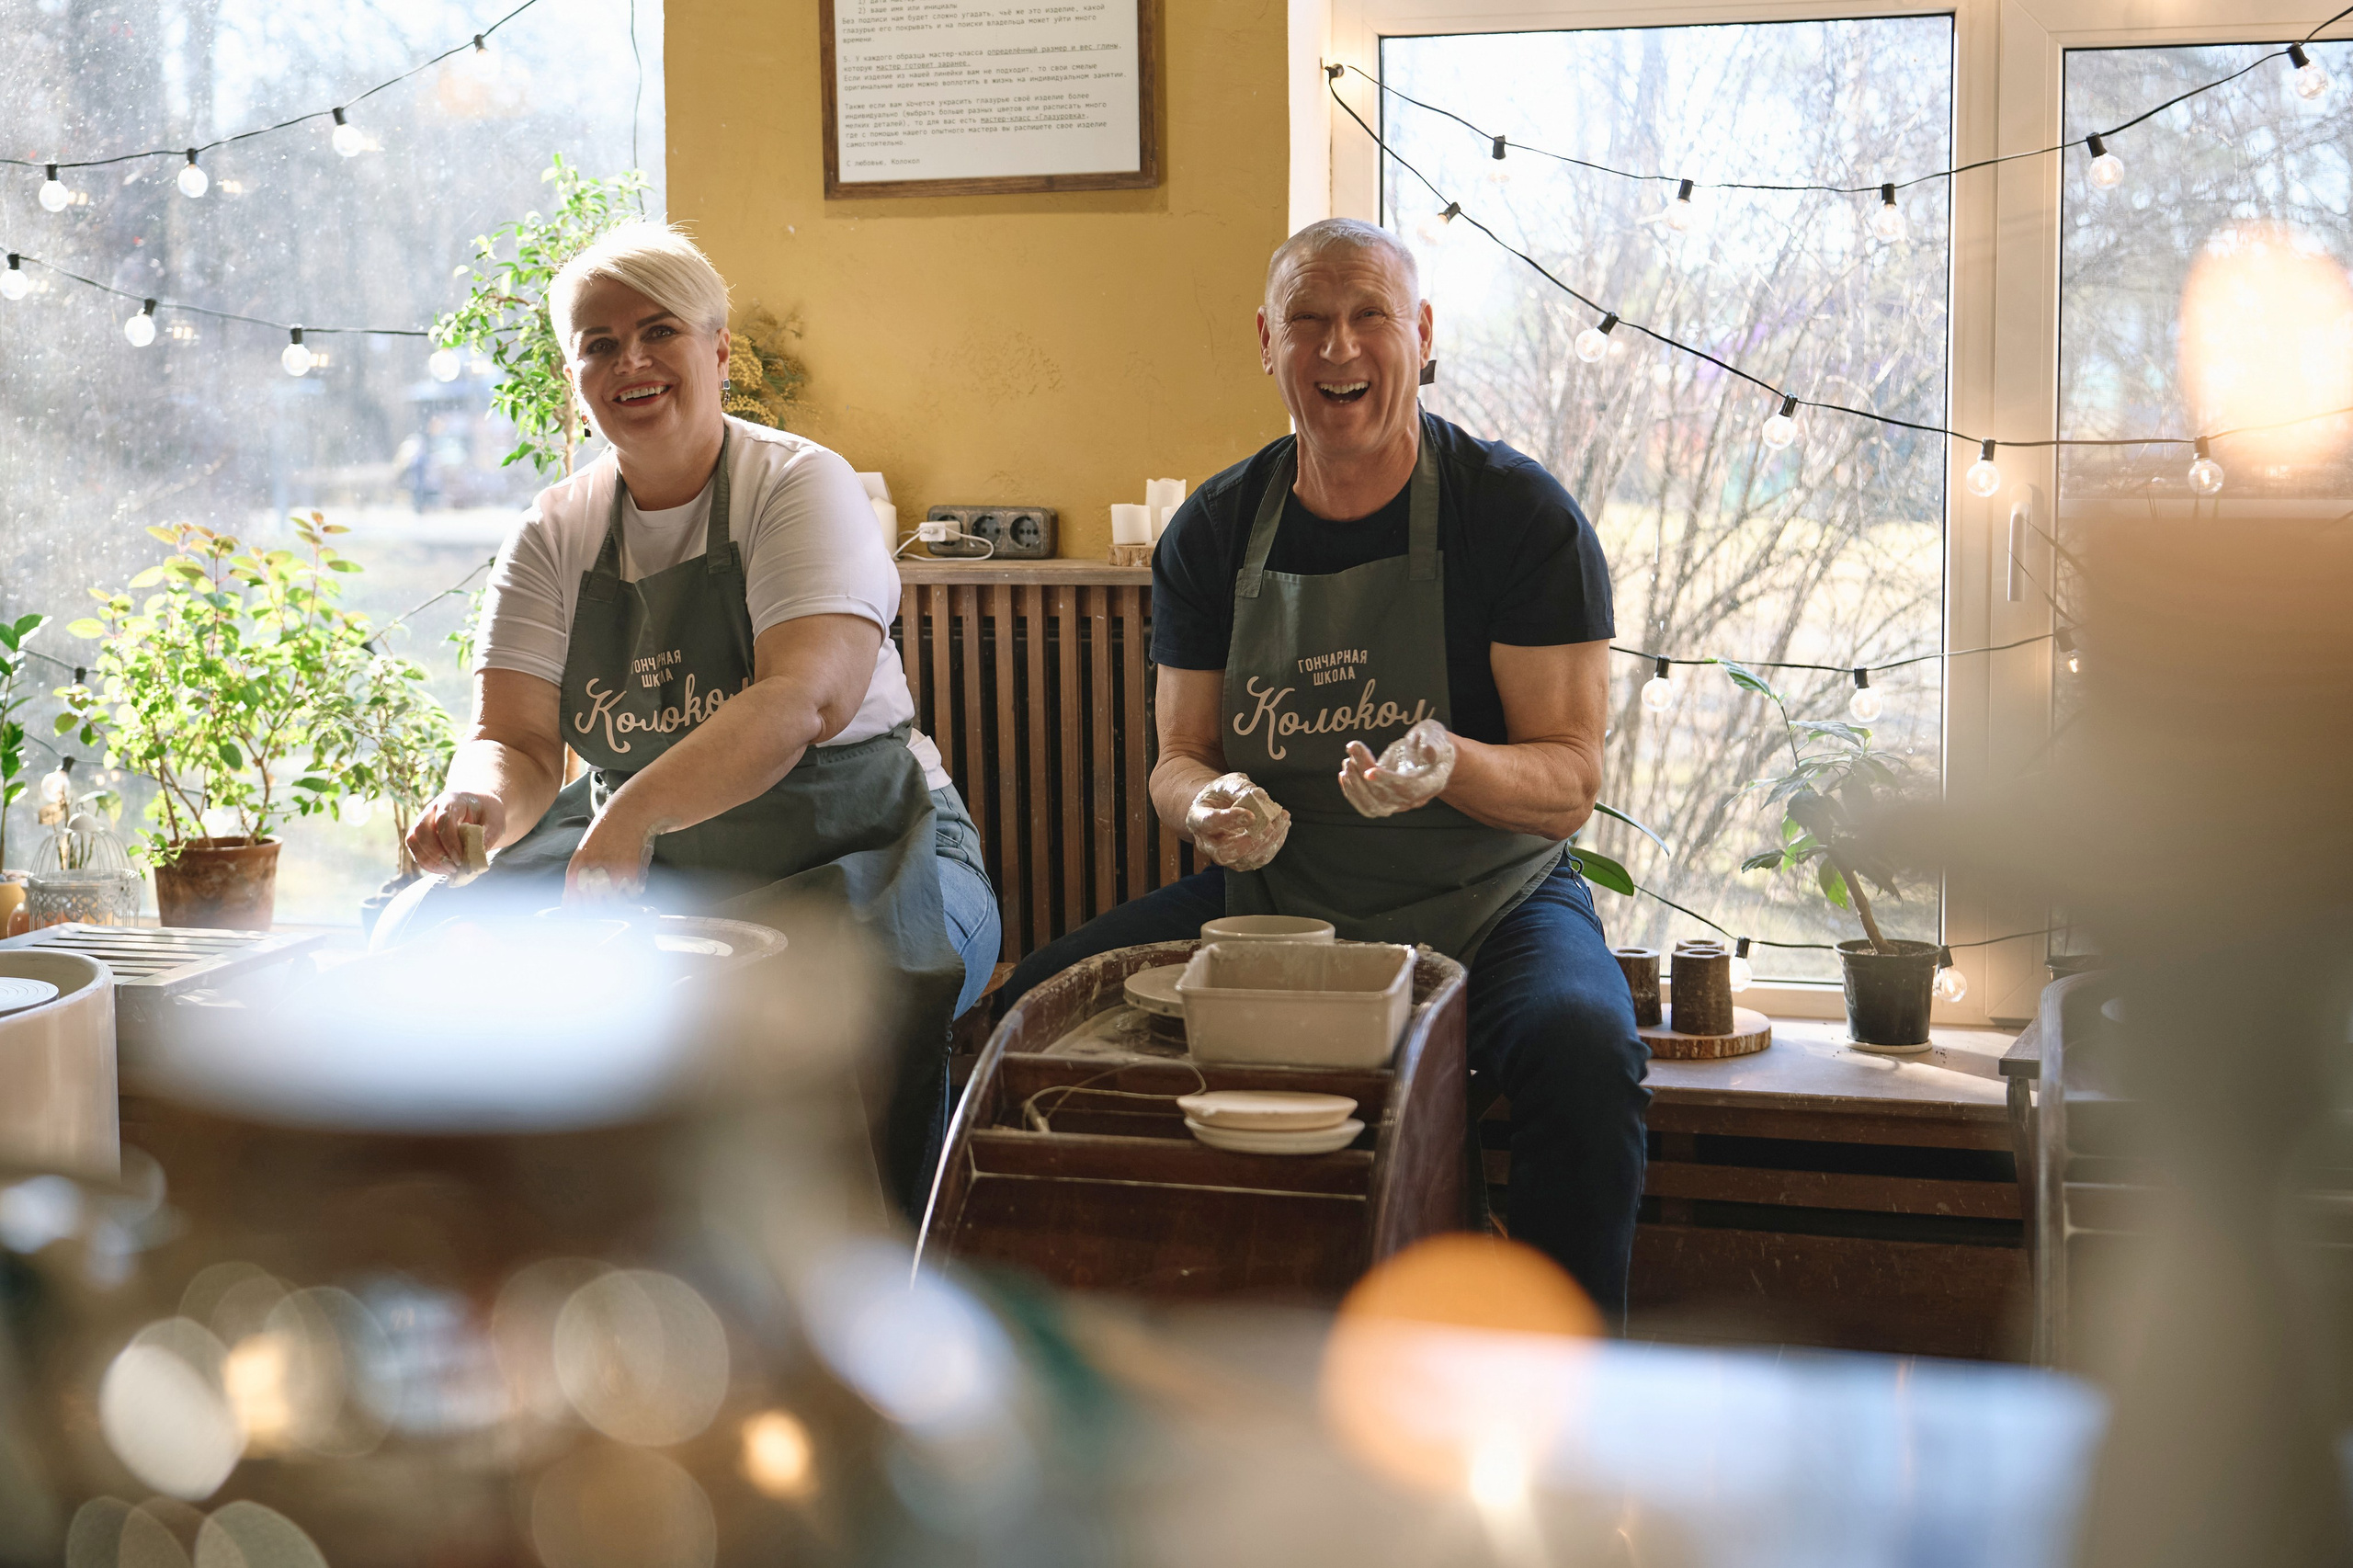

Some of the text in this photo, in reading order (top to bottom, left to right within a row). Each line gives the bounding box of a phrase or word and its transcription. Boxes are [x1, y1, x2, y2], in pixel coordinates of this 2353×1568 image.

[631, 649, 682, 675] ОНЧНАЯ
[1298, 649, 1368, 674] ГОНЧАРНАЯ
[642, 667, 674, 687] ШКЛА
[1313, 665, 1356, 687] ШКОЛА
[574, 673, 749, 754] Колоко
[1233, 676, 1436, 760] Колокол
